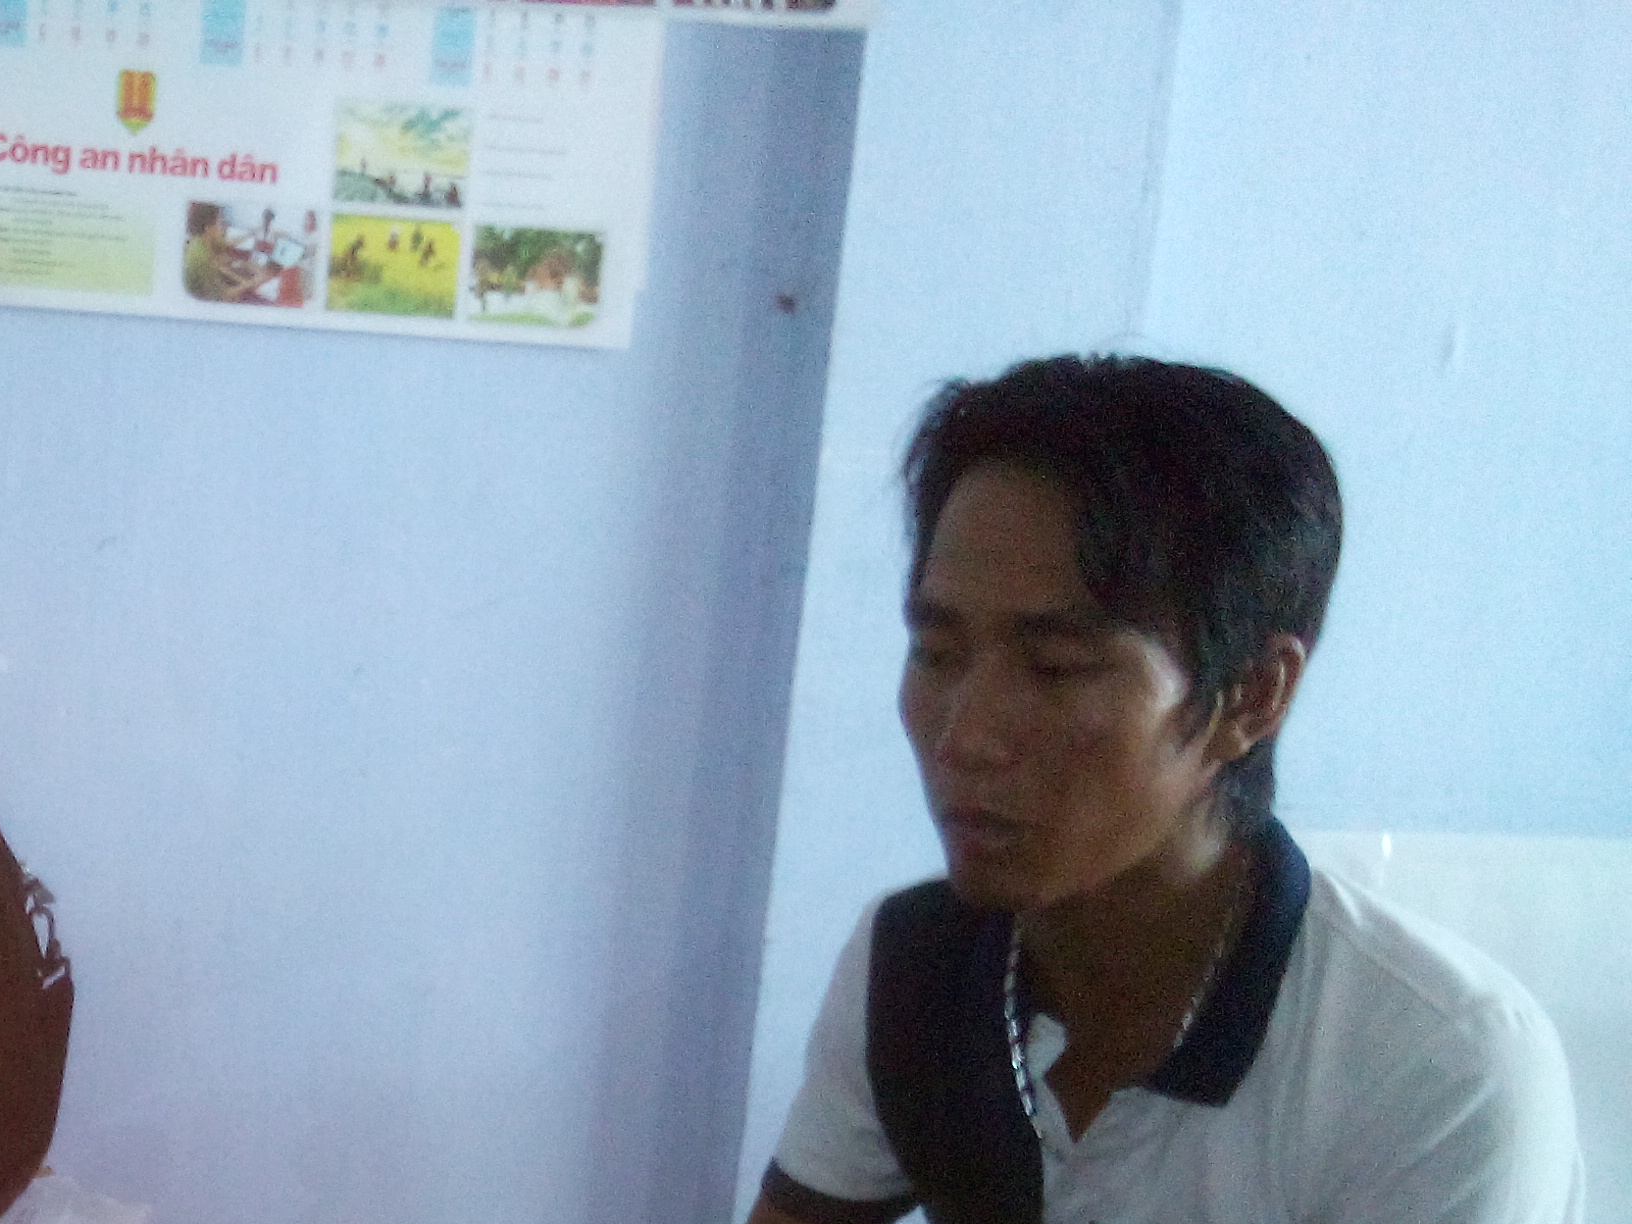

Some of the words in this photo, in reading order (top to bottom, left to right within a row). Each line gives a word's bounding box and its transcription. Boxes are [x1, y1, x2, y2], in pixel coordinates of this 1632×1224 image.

[79, 147, 120, 171] an
[128, 146, 210, 178] nhân
[218, 153, 279, 183] dân
